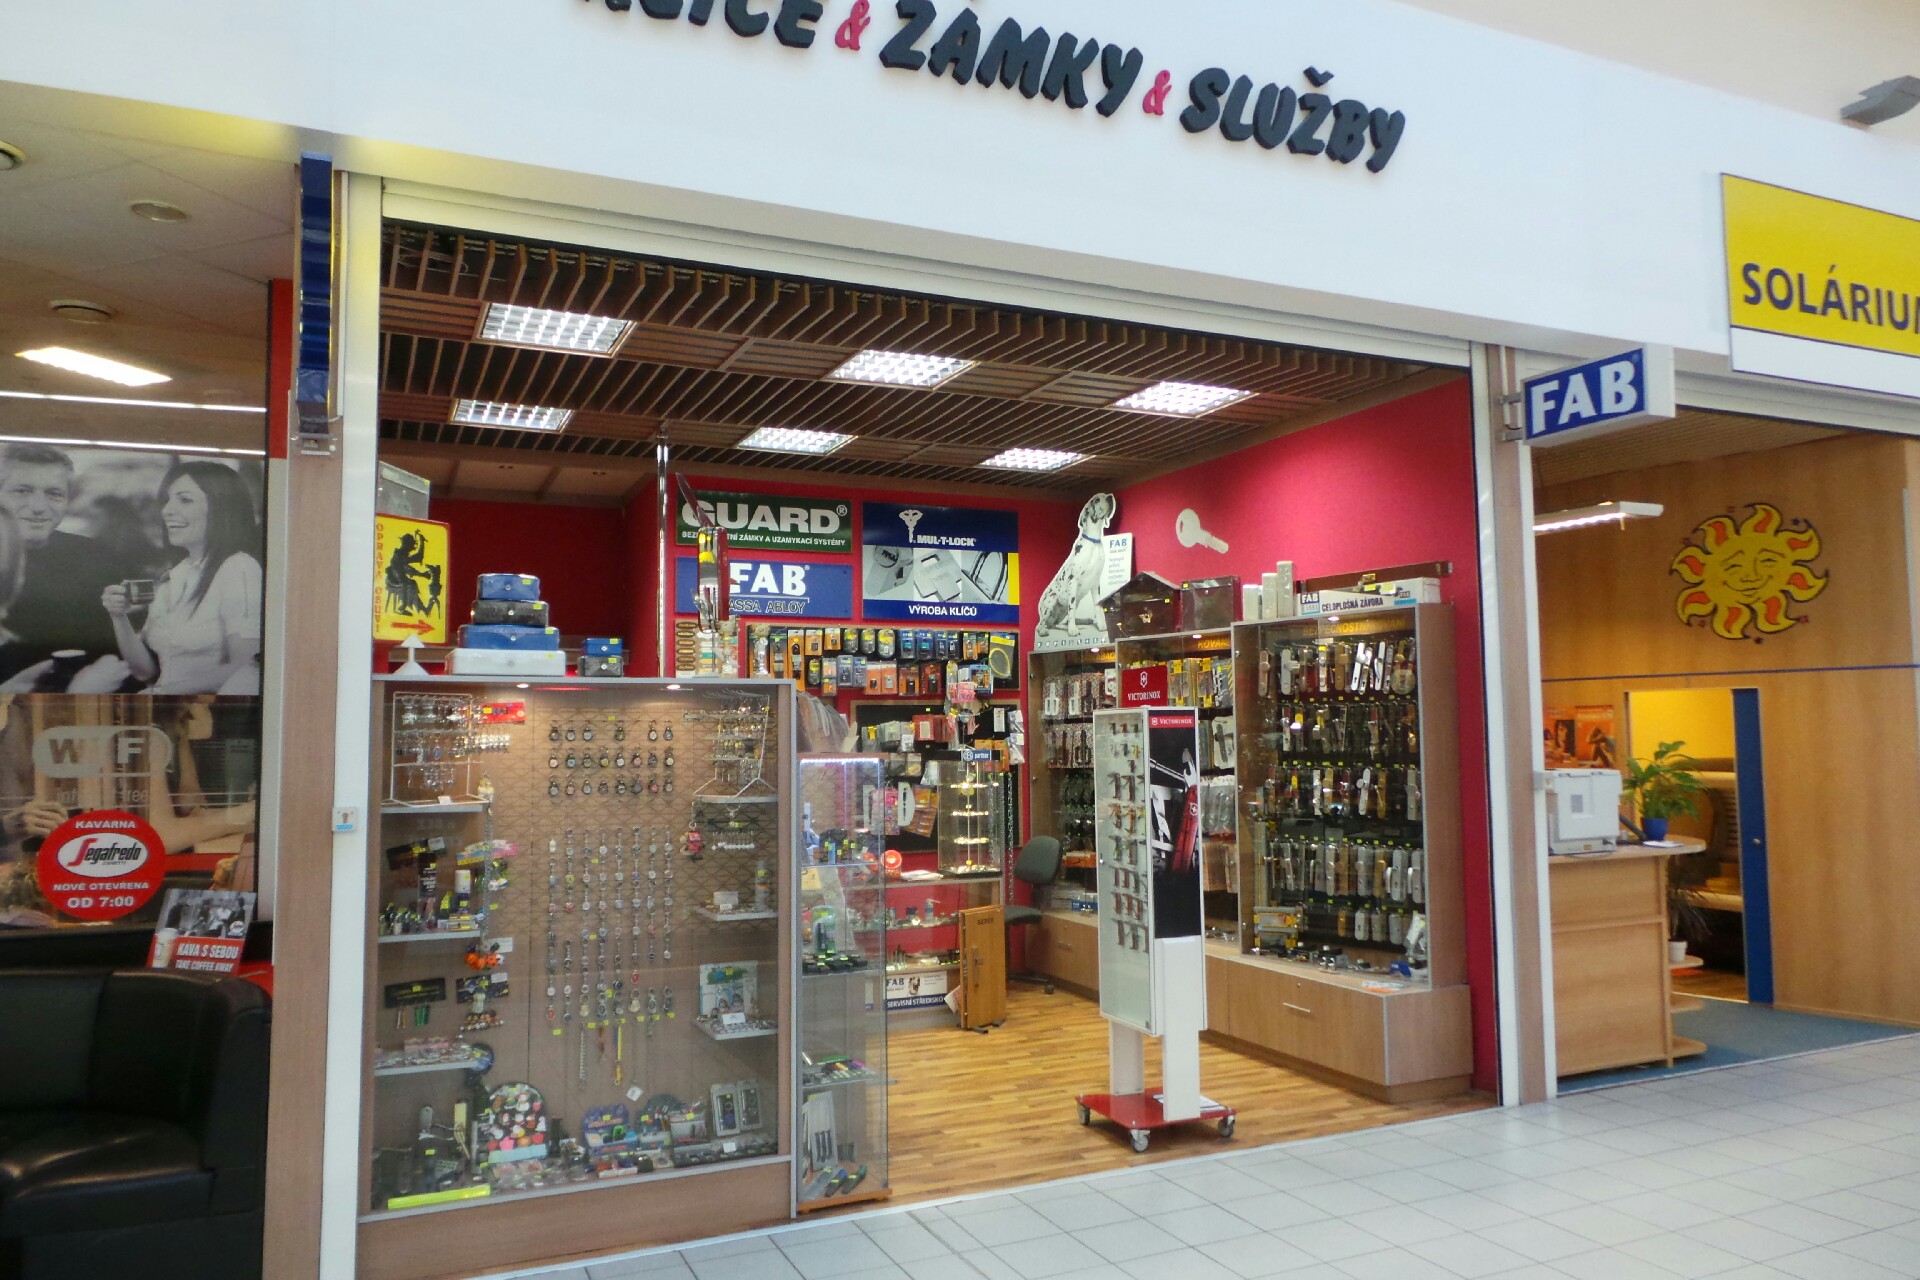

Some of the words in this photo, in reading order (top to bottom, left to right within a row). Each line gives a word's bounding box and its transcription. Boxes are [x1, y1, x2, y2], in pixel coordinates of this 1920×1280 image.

[835, 0, 871, 50] &
[1142, 69, 1172, 116] &
[1179, 65, 1406, 173] SLUŽBY
[1530, 359, 1638, 436] FAB
[1109, 538, 1127, 549] FAB
[375, 524, 383, 577] OPRAVA
[1301, 593, 1318, 604] FAB
[1321, 598, 1359, 613] CELOPLOŠNÁ
[1360, 597, 1384, 609] ZÁVORA
[374, 587, 382, 632] OBUVI
[765, 601, 806, 614] ABLOY
[908, 604, 948, 616] VÝROBA
[1127, 690, 1161, 702] VICTORINOX
[1159, 717, 1193, 726] VICTORINOX
[75, 819, 137, 830] KAVÁRNA
[67, 837, 142, 867] Segafredo
[89, 880, 149, 891] OTEVŘENA
[67, 896, 94, 909] OD
[99, 895, 135, 908] 7:00
[177, 941, 200, 956] KÁVA
[201, 944, 208, 957] S
[209, 945, 239, 959] SEBOU
[175, 959, 192, 969] TAKE
[191, 960, 215, 971] COFFEE
[214, 962, 234, 973] AWAY
[887, 998, 912, 1008] SERVISNÍ
